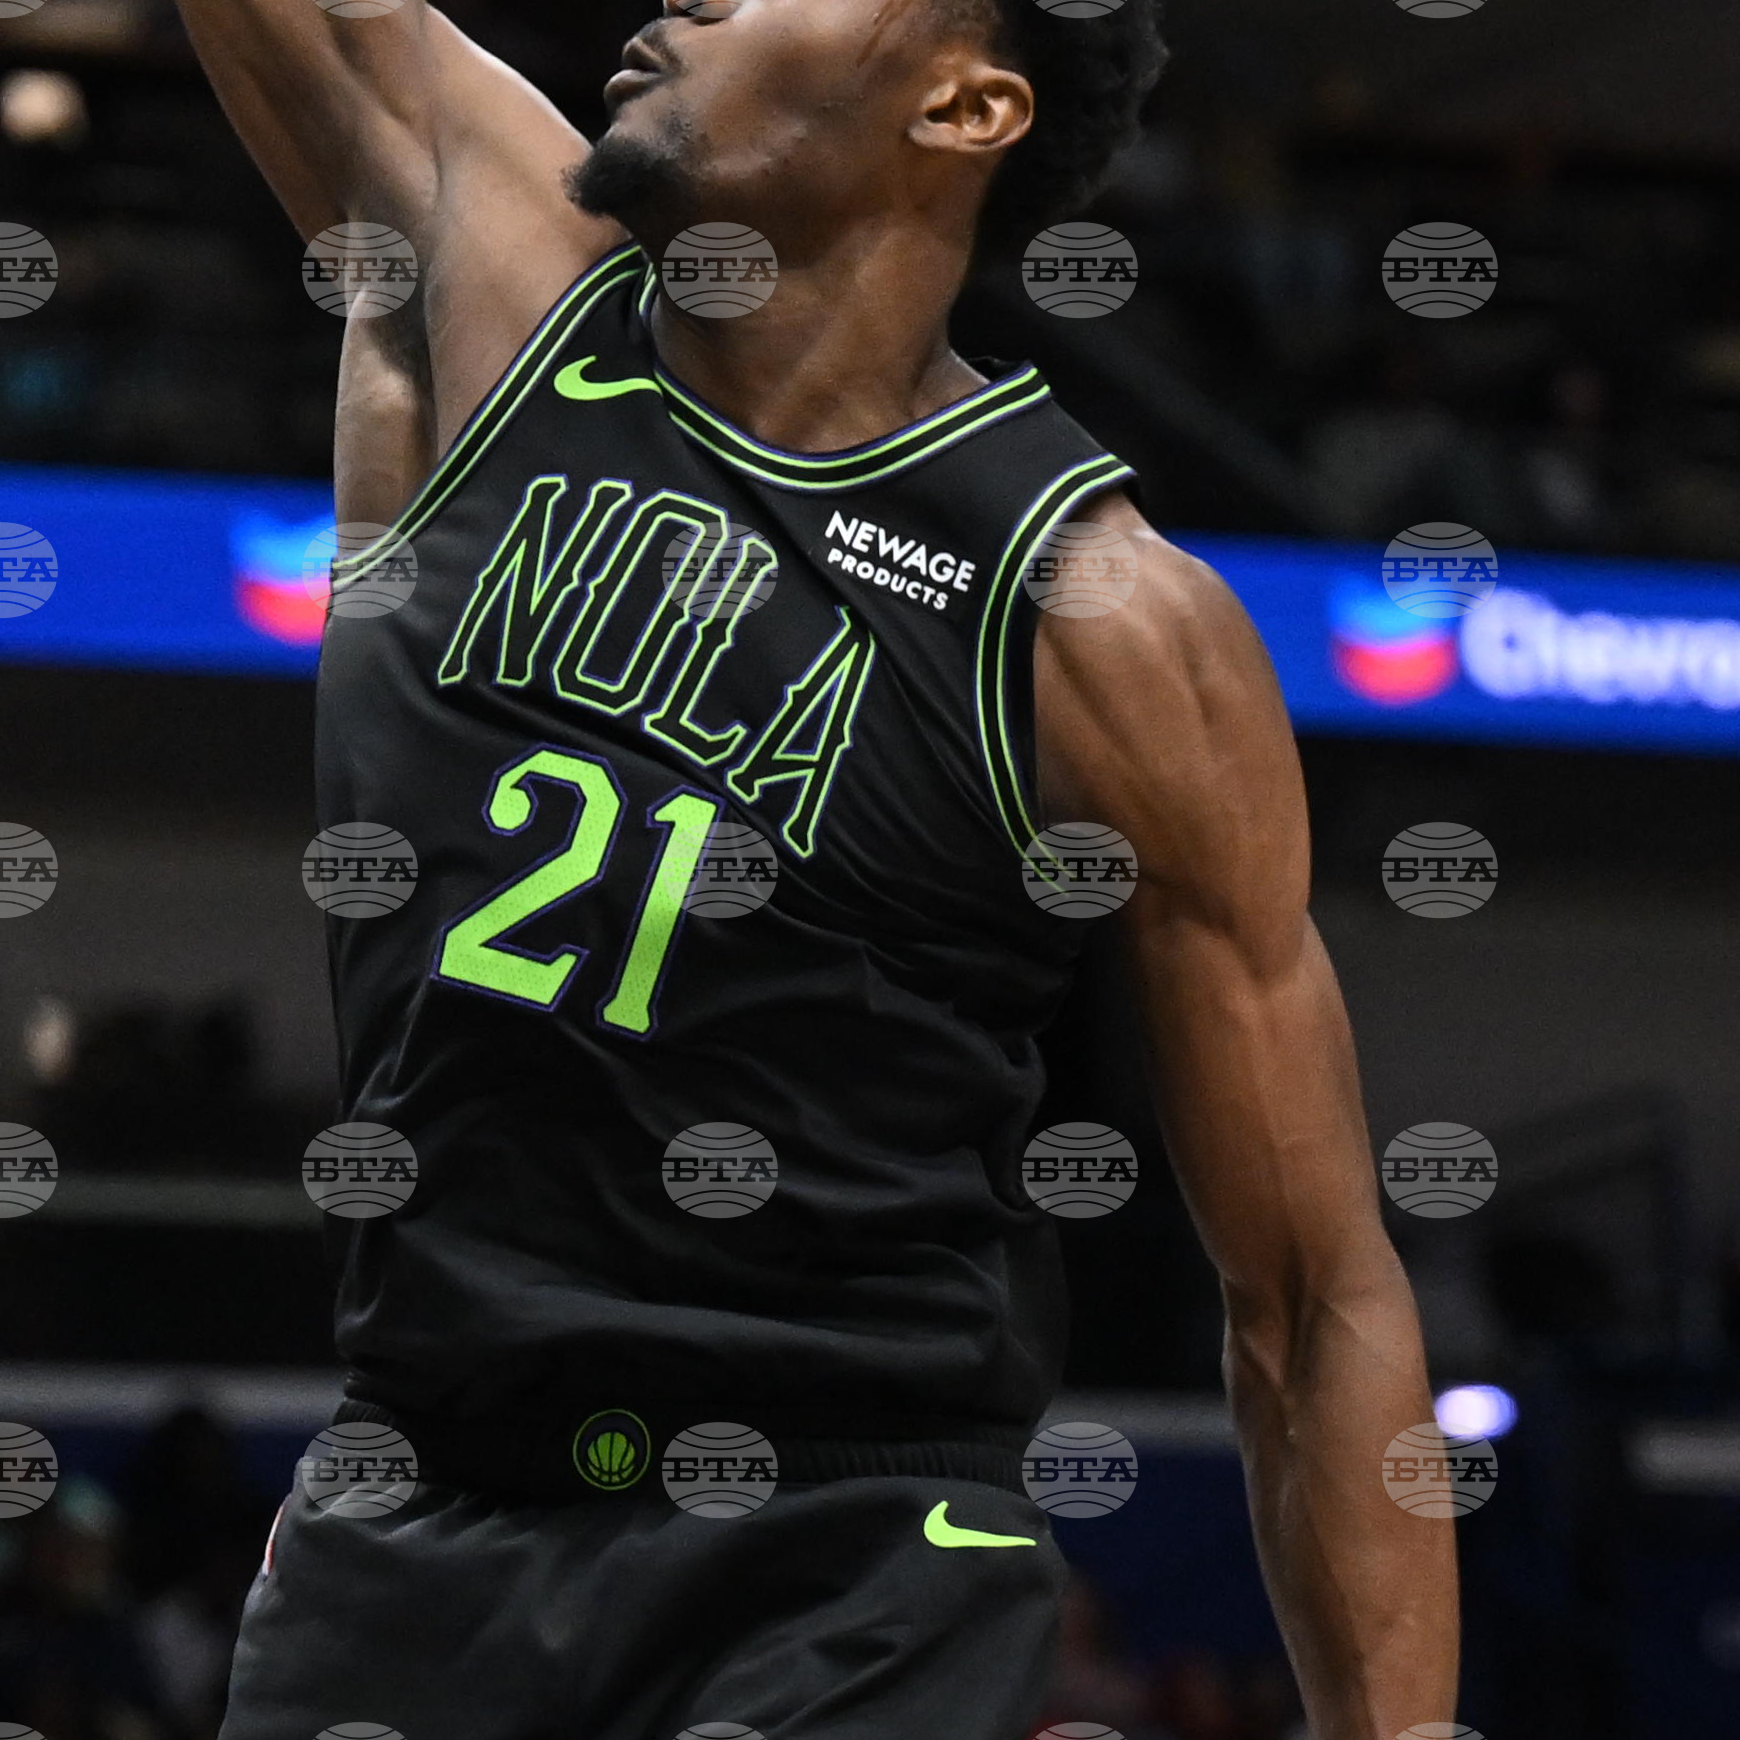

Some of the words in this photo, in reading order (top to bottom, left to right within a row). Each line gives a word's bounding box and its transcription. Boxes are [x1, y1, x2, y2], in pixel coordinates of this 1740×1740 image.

[825, 510, 976, 593] NEWAGE
[827, 548, 948, 611] PRODUCTS
[437, 473, 877, 860] NOLA
[431, 741, 726, 1043] 21
